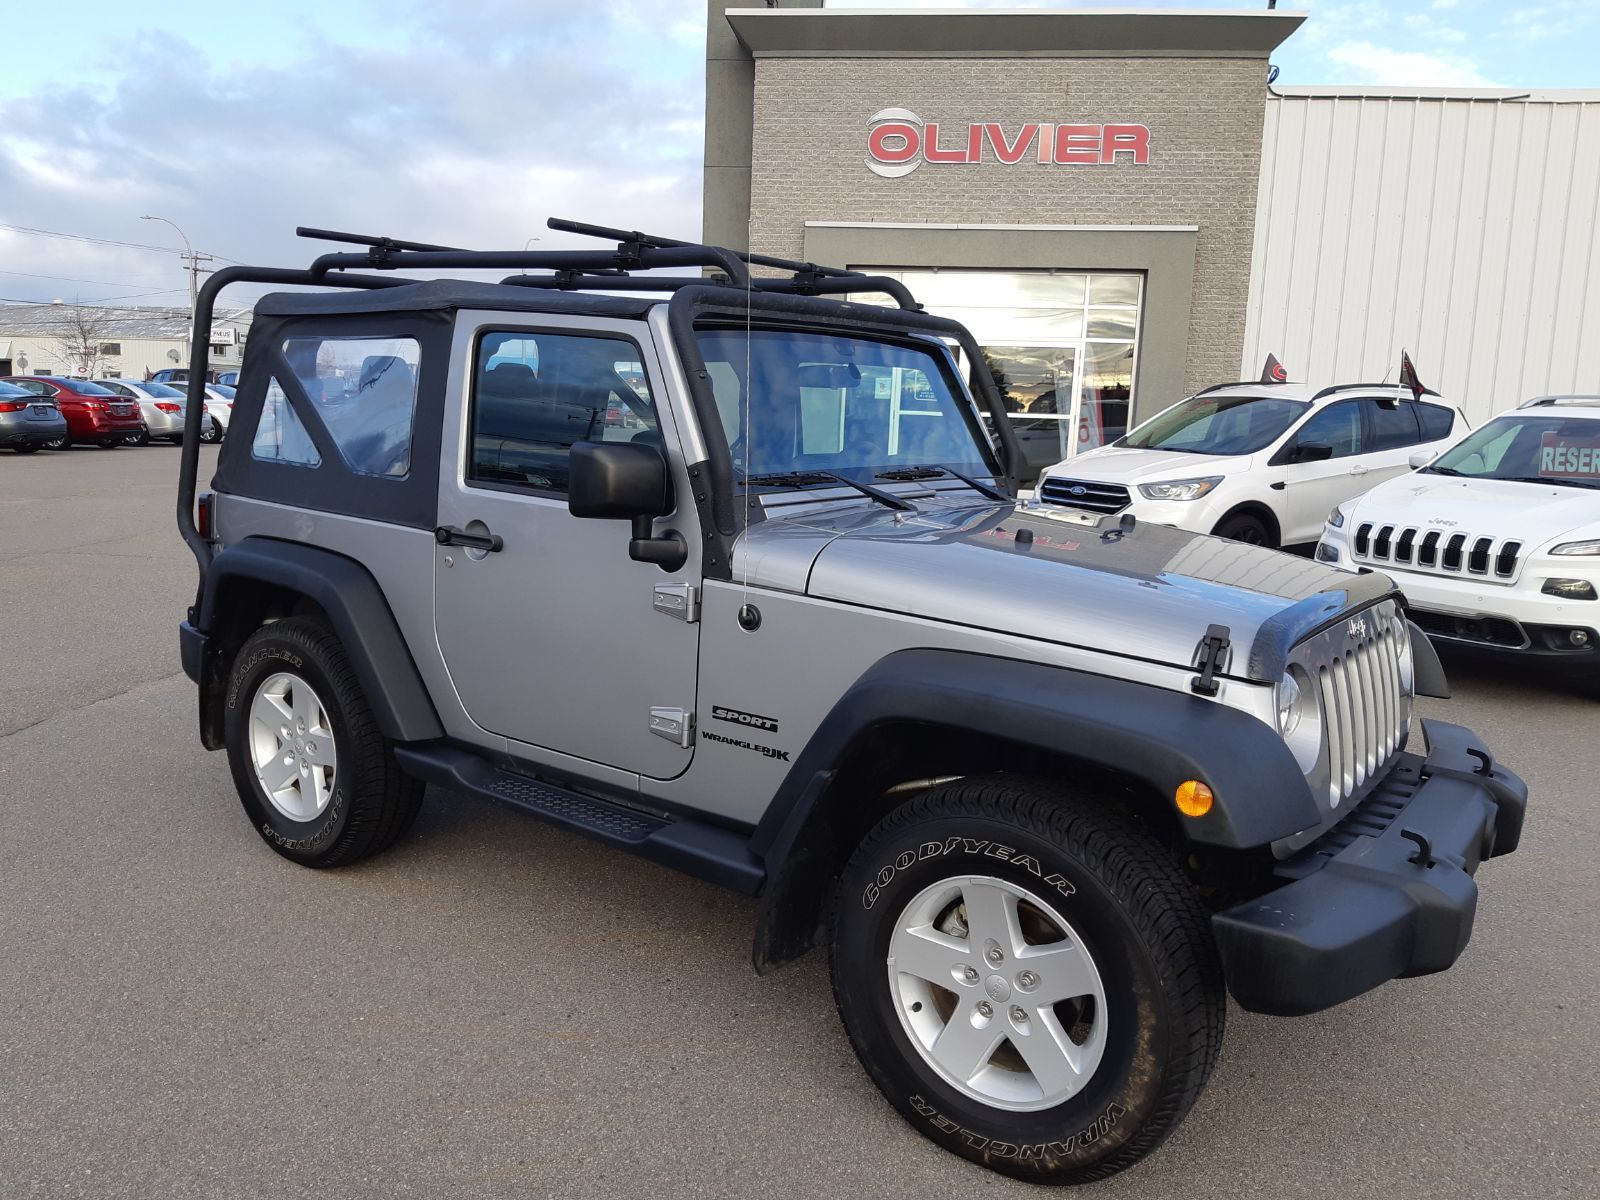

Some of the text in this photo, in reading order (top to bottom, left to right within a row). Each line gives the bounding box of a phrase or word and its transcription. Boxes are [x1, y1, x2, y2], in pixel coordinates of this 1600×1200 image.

[866, 120, 1151, 165] OLIVIER
[228, 648, 303, 708] WRANGLER
[714, 707, 778, 731] SPORT
[262, 788, 343, 850] GOODYEAR
[862, 837, 1077, 910] GOODYEAR
[909, 1093, 1128, 1160] WRANGLER
